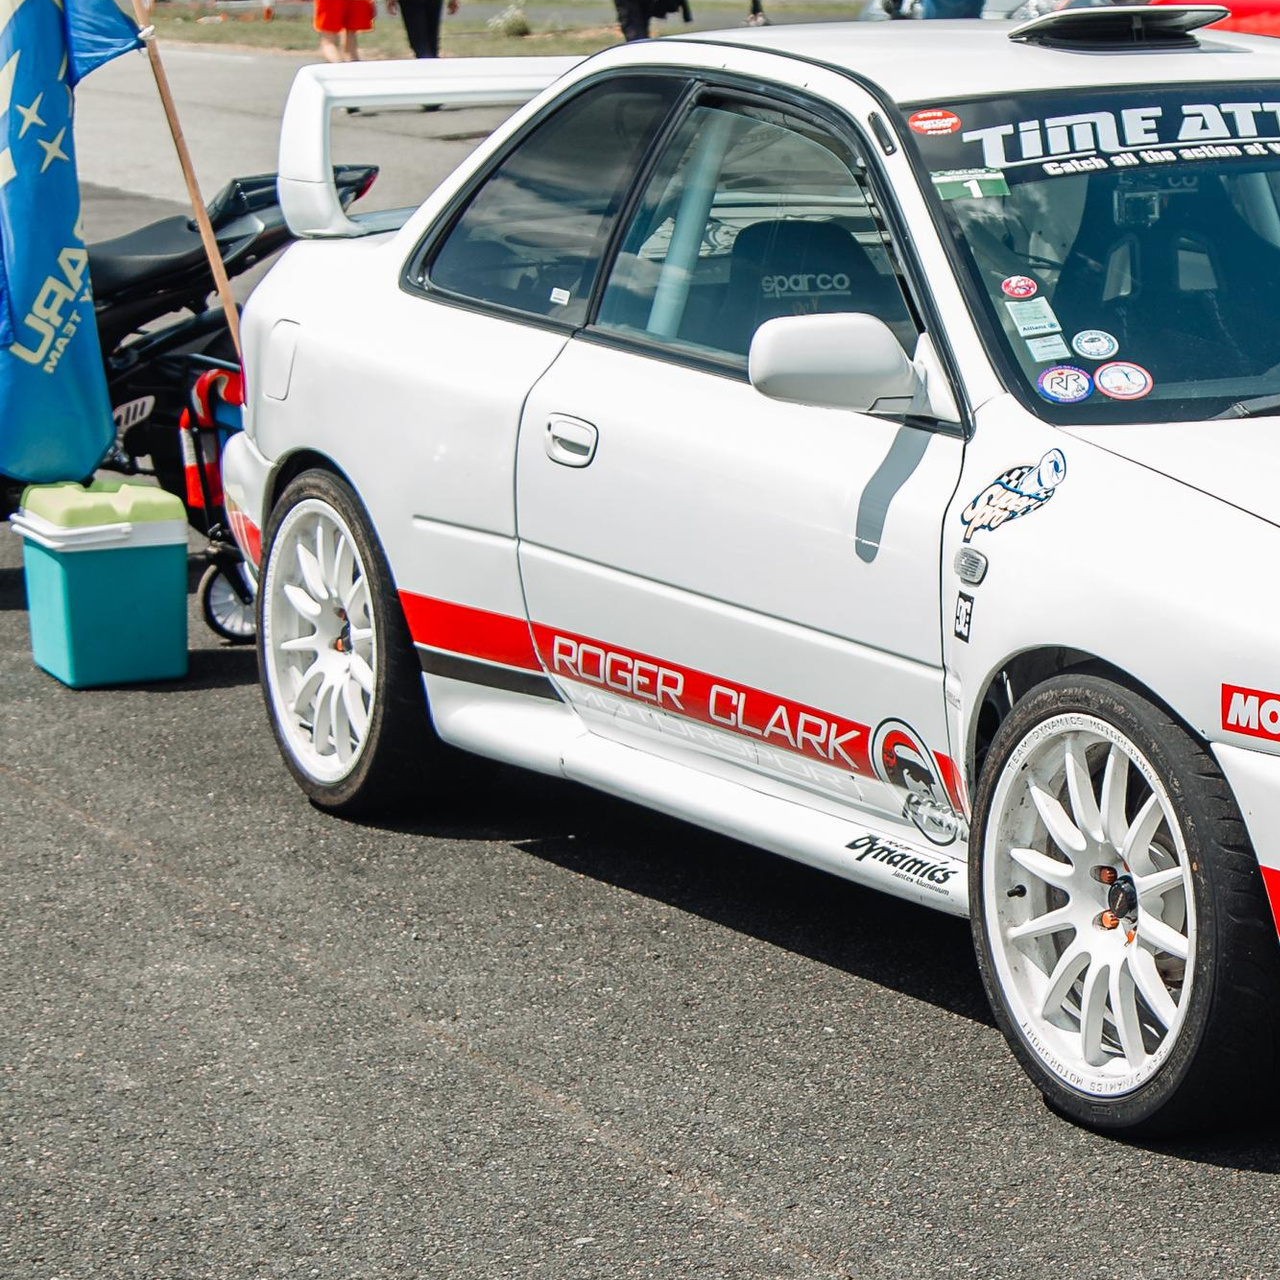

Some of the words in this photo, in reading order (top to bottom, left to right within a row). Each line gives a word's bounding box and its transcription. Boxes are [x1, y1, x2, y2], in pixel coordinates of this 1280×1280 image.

[1042, 155, 1108, 176] Catch
[1112, 152, 1139, 167] all
[1139, 147, 1177, 164] the
[1180, 143, 1242, 161] action
[1243, 141, 1268, 157] at
[962, 179, 983, 199] 1
[761, 273, 850, 298] sparco
[552, 634, 684, 711] ROGER
[708, 684, 863, 770] CLARK
[1007, 741, 1028, 771] TEAM
[1033, 716, 1085, 741] DYNAMICS
[844, 832, 959, 885] Dynamics
